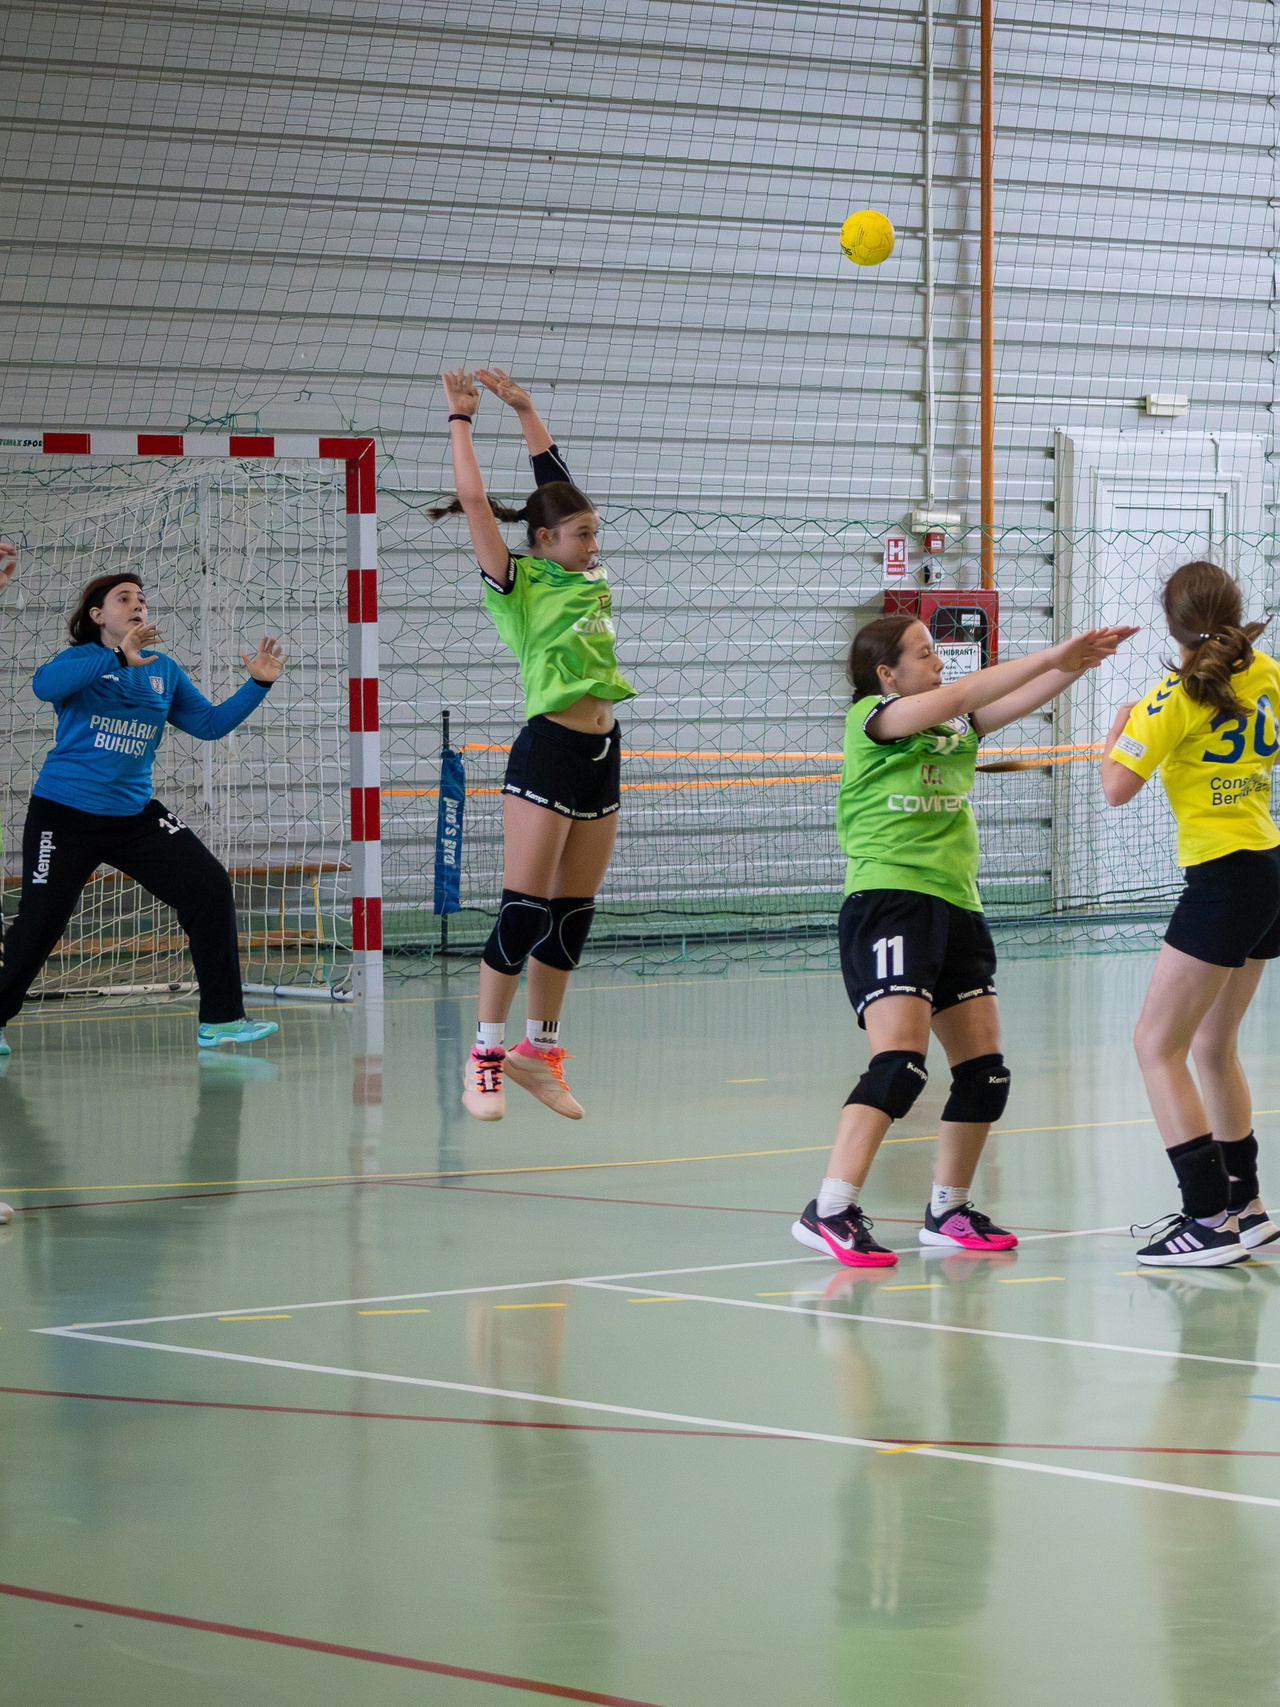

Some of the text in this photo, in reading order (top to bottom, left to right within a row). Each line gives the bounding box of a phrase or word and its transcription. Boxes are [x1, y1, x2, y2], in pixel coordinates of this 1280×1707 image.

[889, 541, 904, 560] H
[943, 648, 974, 656] HIDRANT
[89, 714, 158, 740] PRIMĂRIA
[1202, 694, 1280, 764] 30
[93, 732, 148, 759] BUHUȘI
[32, 831, 57, 885] Kempa
[872, 935, 904, 980] 11
[890, 984, 917, 993] Kempa
[957, 988, 984, 1000] Kempa
